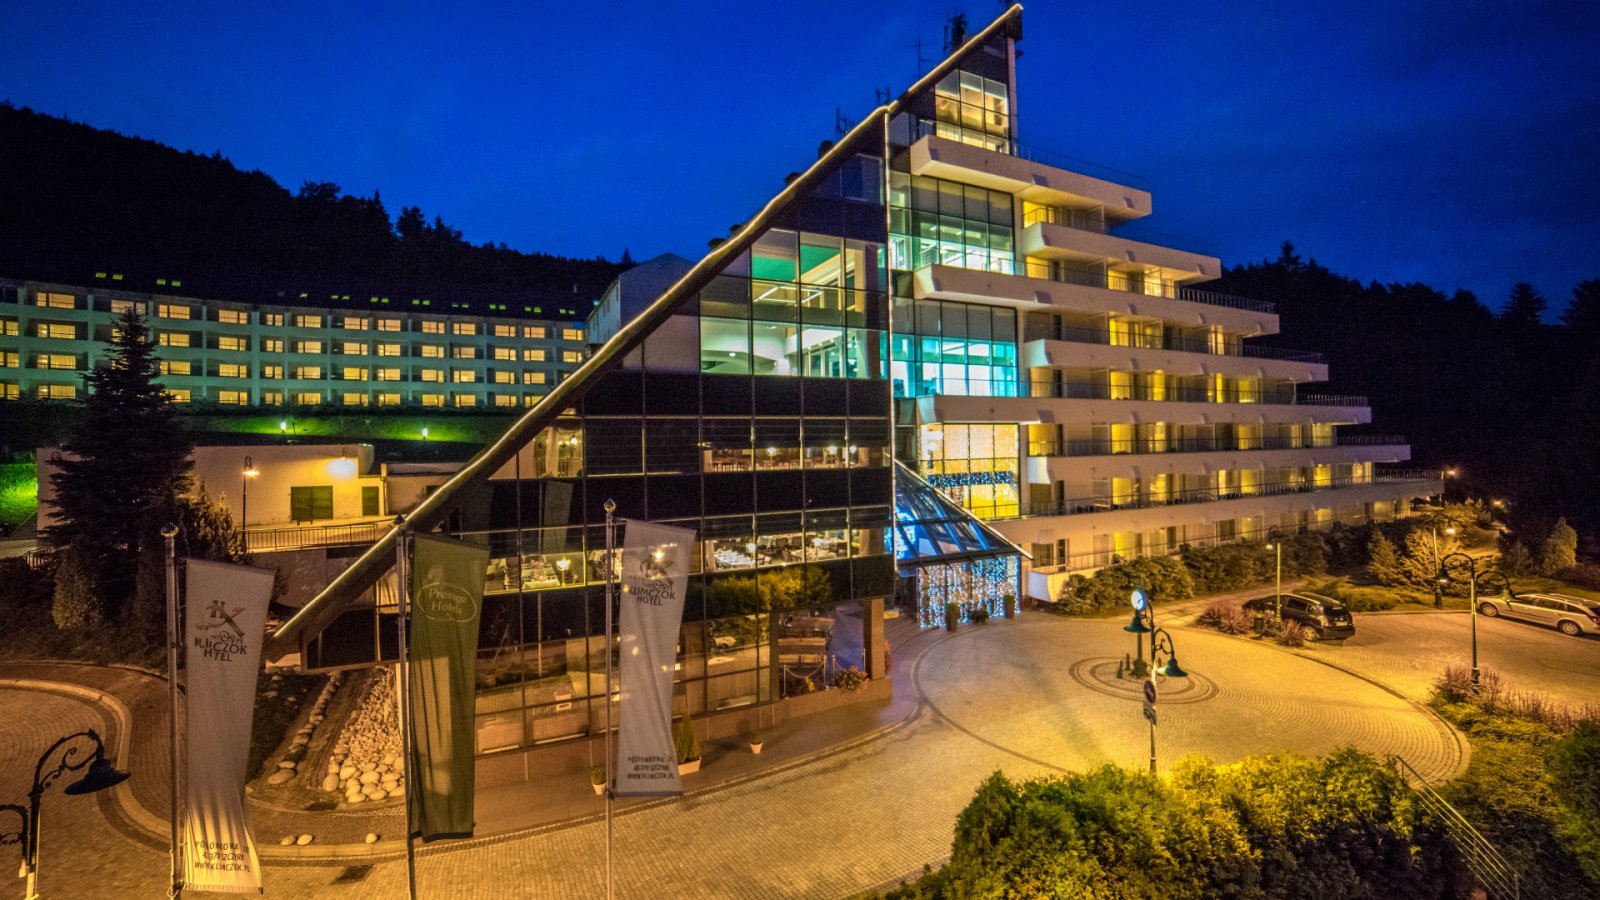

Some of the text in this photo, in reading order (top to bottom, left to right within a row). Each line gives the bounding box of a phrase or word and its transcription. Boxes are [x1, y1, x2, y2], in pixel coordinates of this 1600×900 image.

[428, 588, 468, 604] Prestige
[629, 586, 676, 600] KLIMCZOK
[637, 595, 663, 606] HOTEL
[431, 601, 463, 615] Hotels
[203, 648, 232, 662] HTEL
